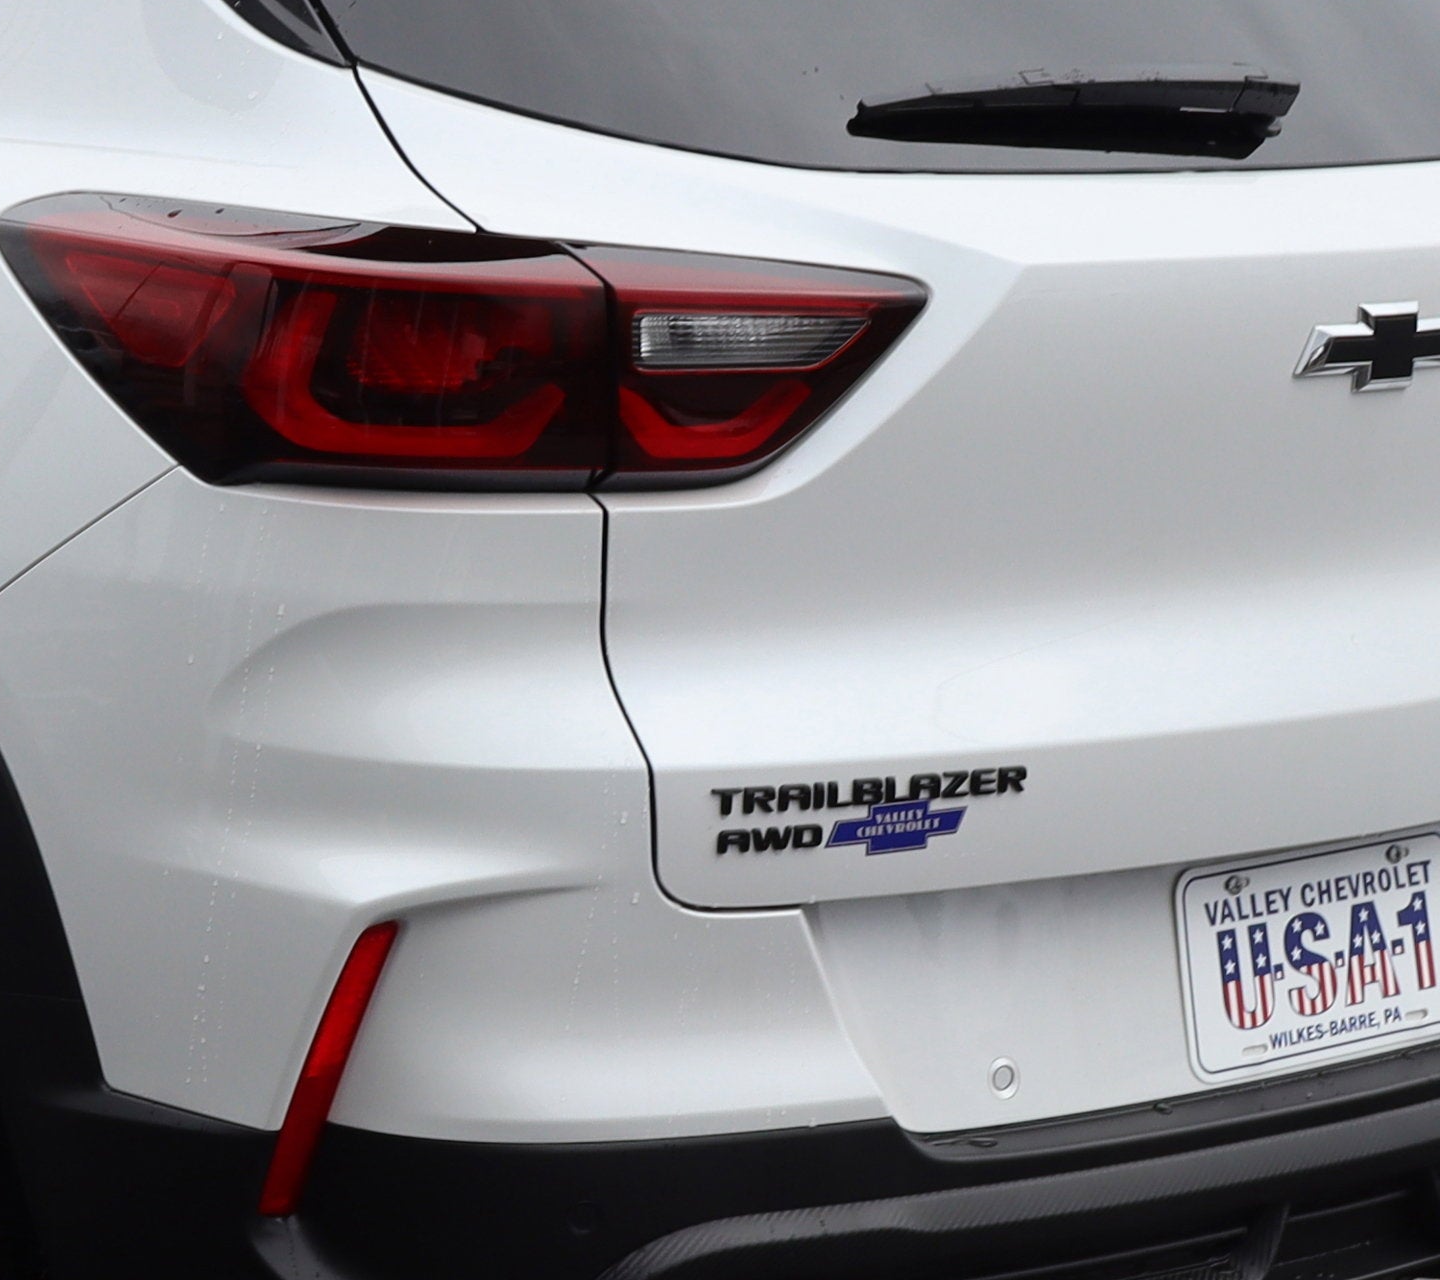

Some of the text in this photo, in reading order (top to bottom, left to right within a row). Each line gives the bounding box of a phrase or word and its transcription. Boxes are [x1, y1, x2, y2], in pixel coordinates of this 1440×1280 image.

[711, 766, 1028, 816] TRAILBLAZER
[855, 816, 941, 839] CHEVROLET
[875, 807, 925, 825] VALLEY
[716, 823, 824, 854] AWD
[1204, 859, 1432, 926] VALLEY CHEVROLET
[1269, 1006, 1403, 1050] WILKES-BARRE, PA
